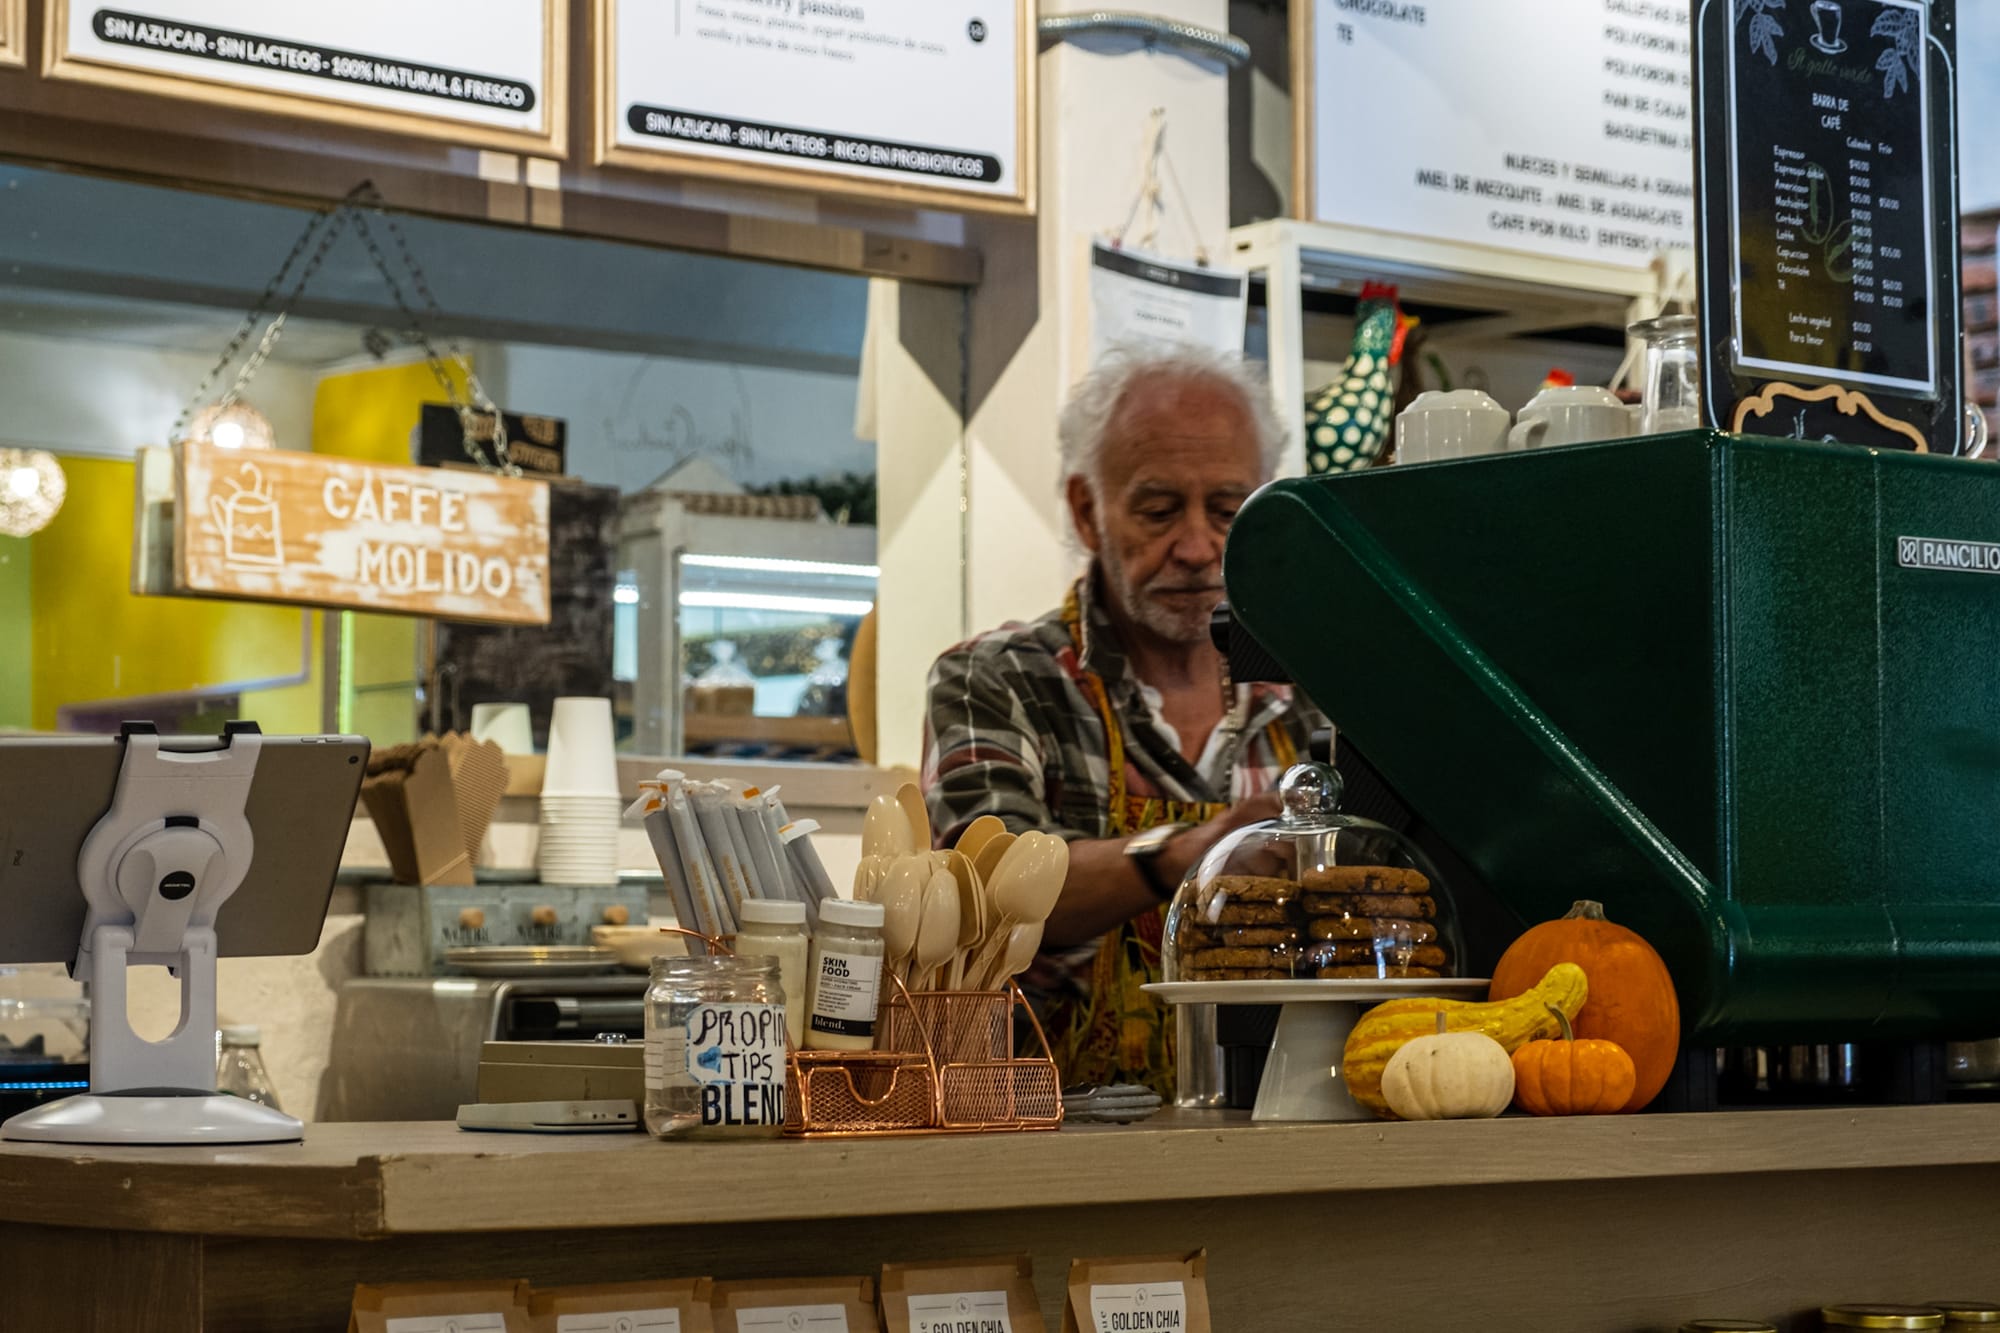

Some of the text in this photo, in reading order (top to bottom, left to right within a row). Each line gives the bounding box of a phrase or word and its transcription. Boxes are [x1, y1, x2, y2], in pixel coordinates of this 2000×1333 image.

[104, 17, 525, 107] SIN AZUCAR SIN LACTEOS 100% NATURAL & FRESCO
[1812, 92, 1849, 112] BARRA DE
[646, 112, 984, 177] SIN AZUCAR SIN LACTEOS RICO EN PROBIOTICOS
[1846, 136, 1871, 151] Caliente
[1773, 145, 1805, 160] Espresso
[1774, 161, 1806, 177] Espresso
[1775, 179, 1809, 193] Americano
[1776, 212, 1804, 226] Cortado
[1776, 229, 1795, 241] Latte
[1777, 262, 1810, 277] Chocolate
[1789, 312, 1807, 324] Leche
[1809, 317, 1832, 330] vegetal
[1790, 331, 1805, 343] Para
[1806, 333, 1824, 345] llevar
[322, 475, 467, 532] CAFFE
[1923, 543, 2000, 569] RANCILIO
[360, 542, 512, 598] MOLIDO
[823, 957, 847, 968] SKIN
[822, 965, 850, 977] FOOD
[815, 1017, 845, 1030] blend.
[702, 1084, 785, 1126] BLEND
[1112, 1311, 1153, 1331] GOLDEN
[1156, 1310, 1180, 1328] CHIA
